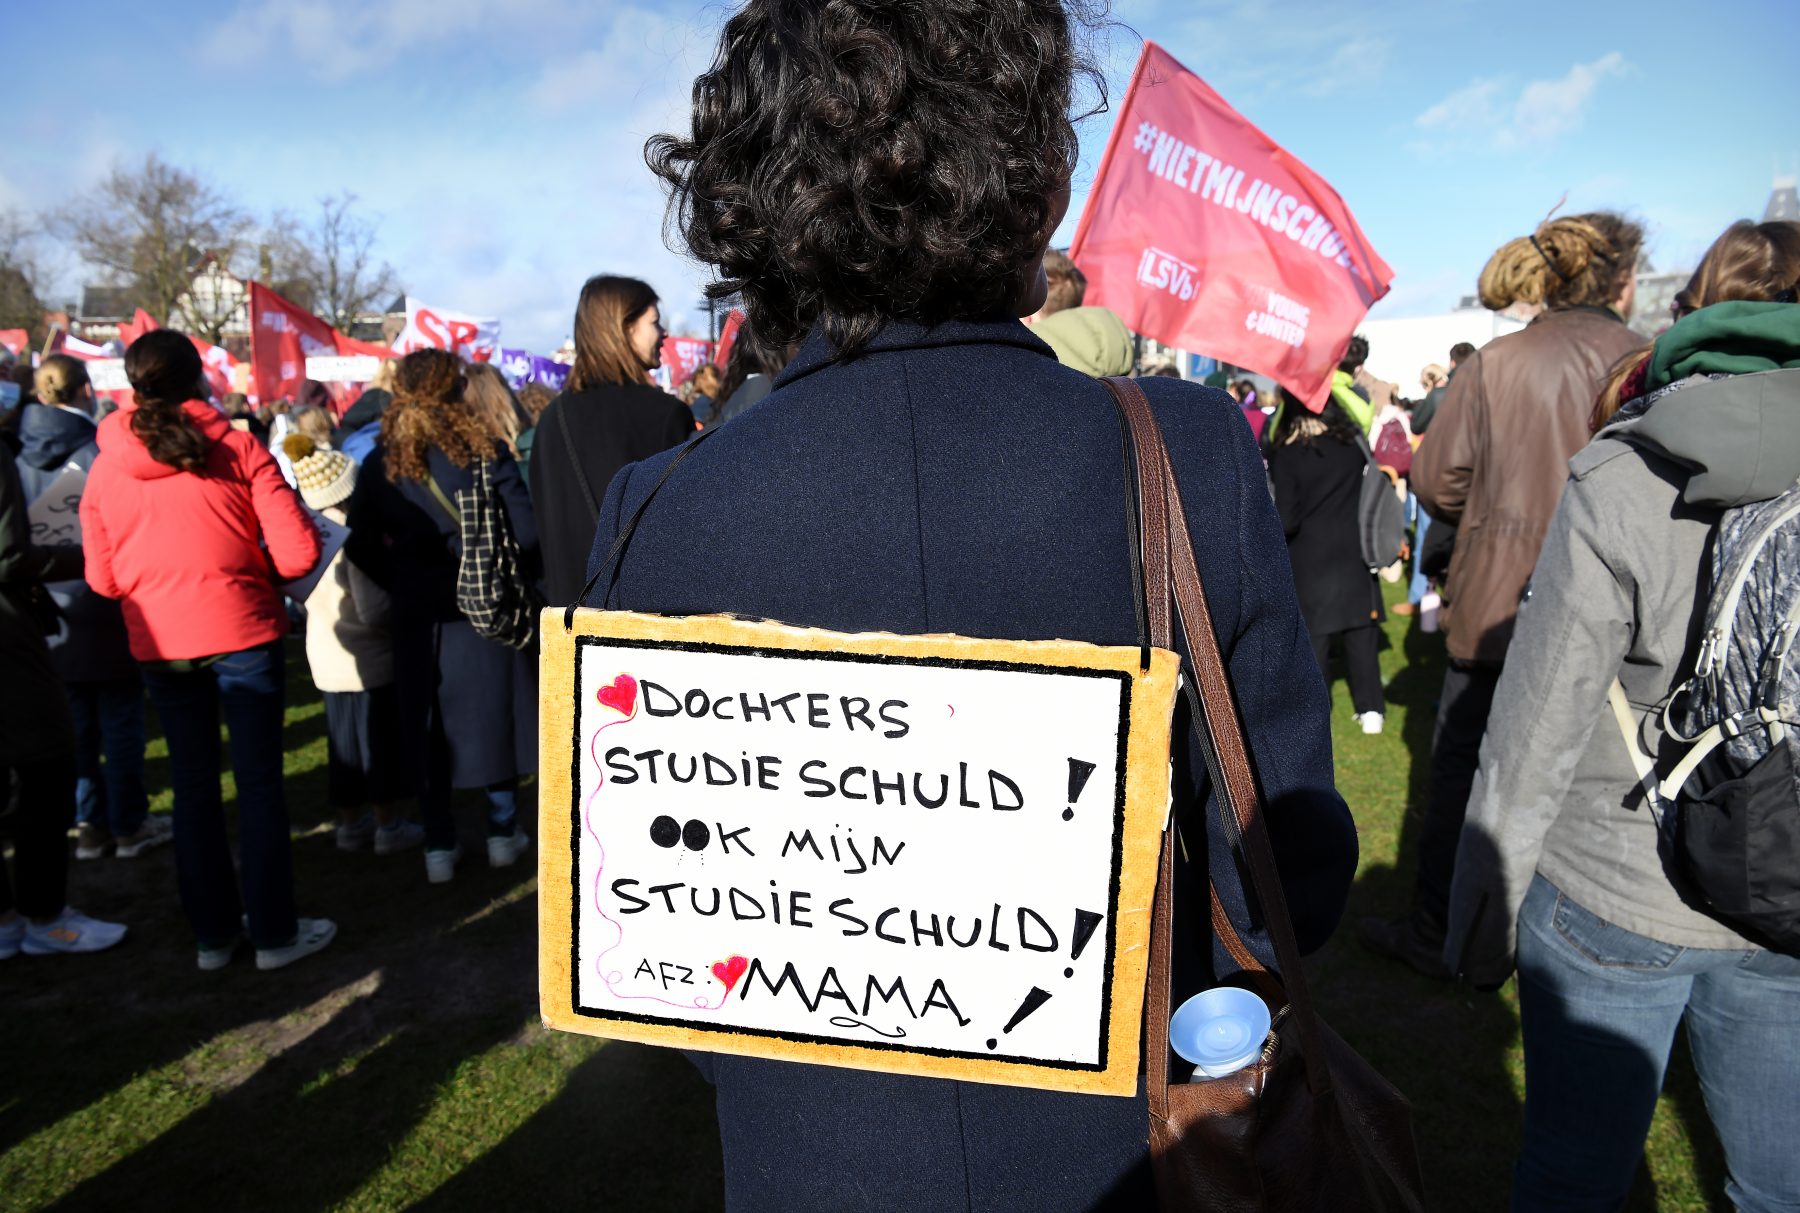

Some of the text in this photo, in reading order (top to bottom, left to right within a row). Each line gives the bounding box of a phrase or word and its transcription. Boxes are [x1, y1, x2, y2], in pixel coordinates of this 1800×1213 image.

[1141, 250, 1193, 301] LSVb
[1267, 290, 1311, 329] YOUNG
[640, 680, 910, 739] DOCHTERS
[649, 815, 756, 857] OOK
